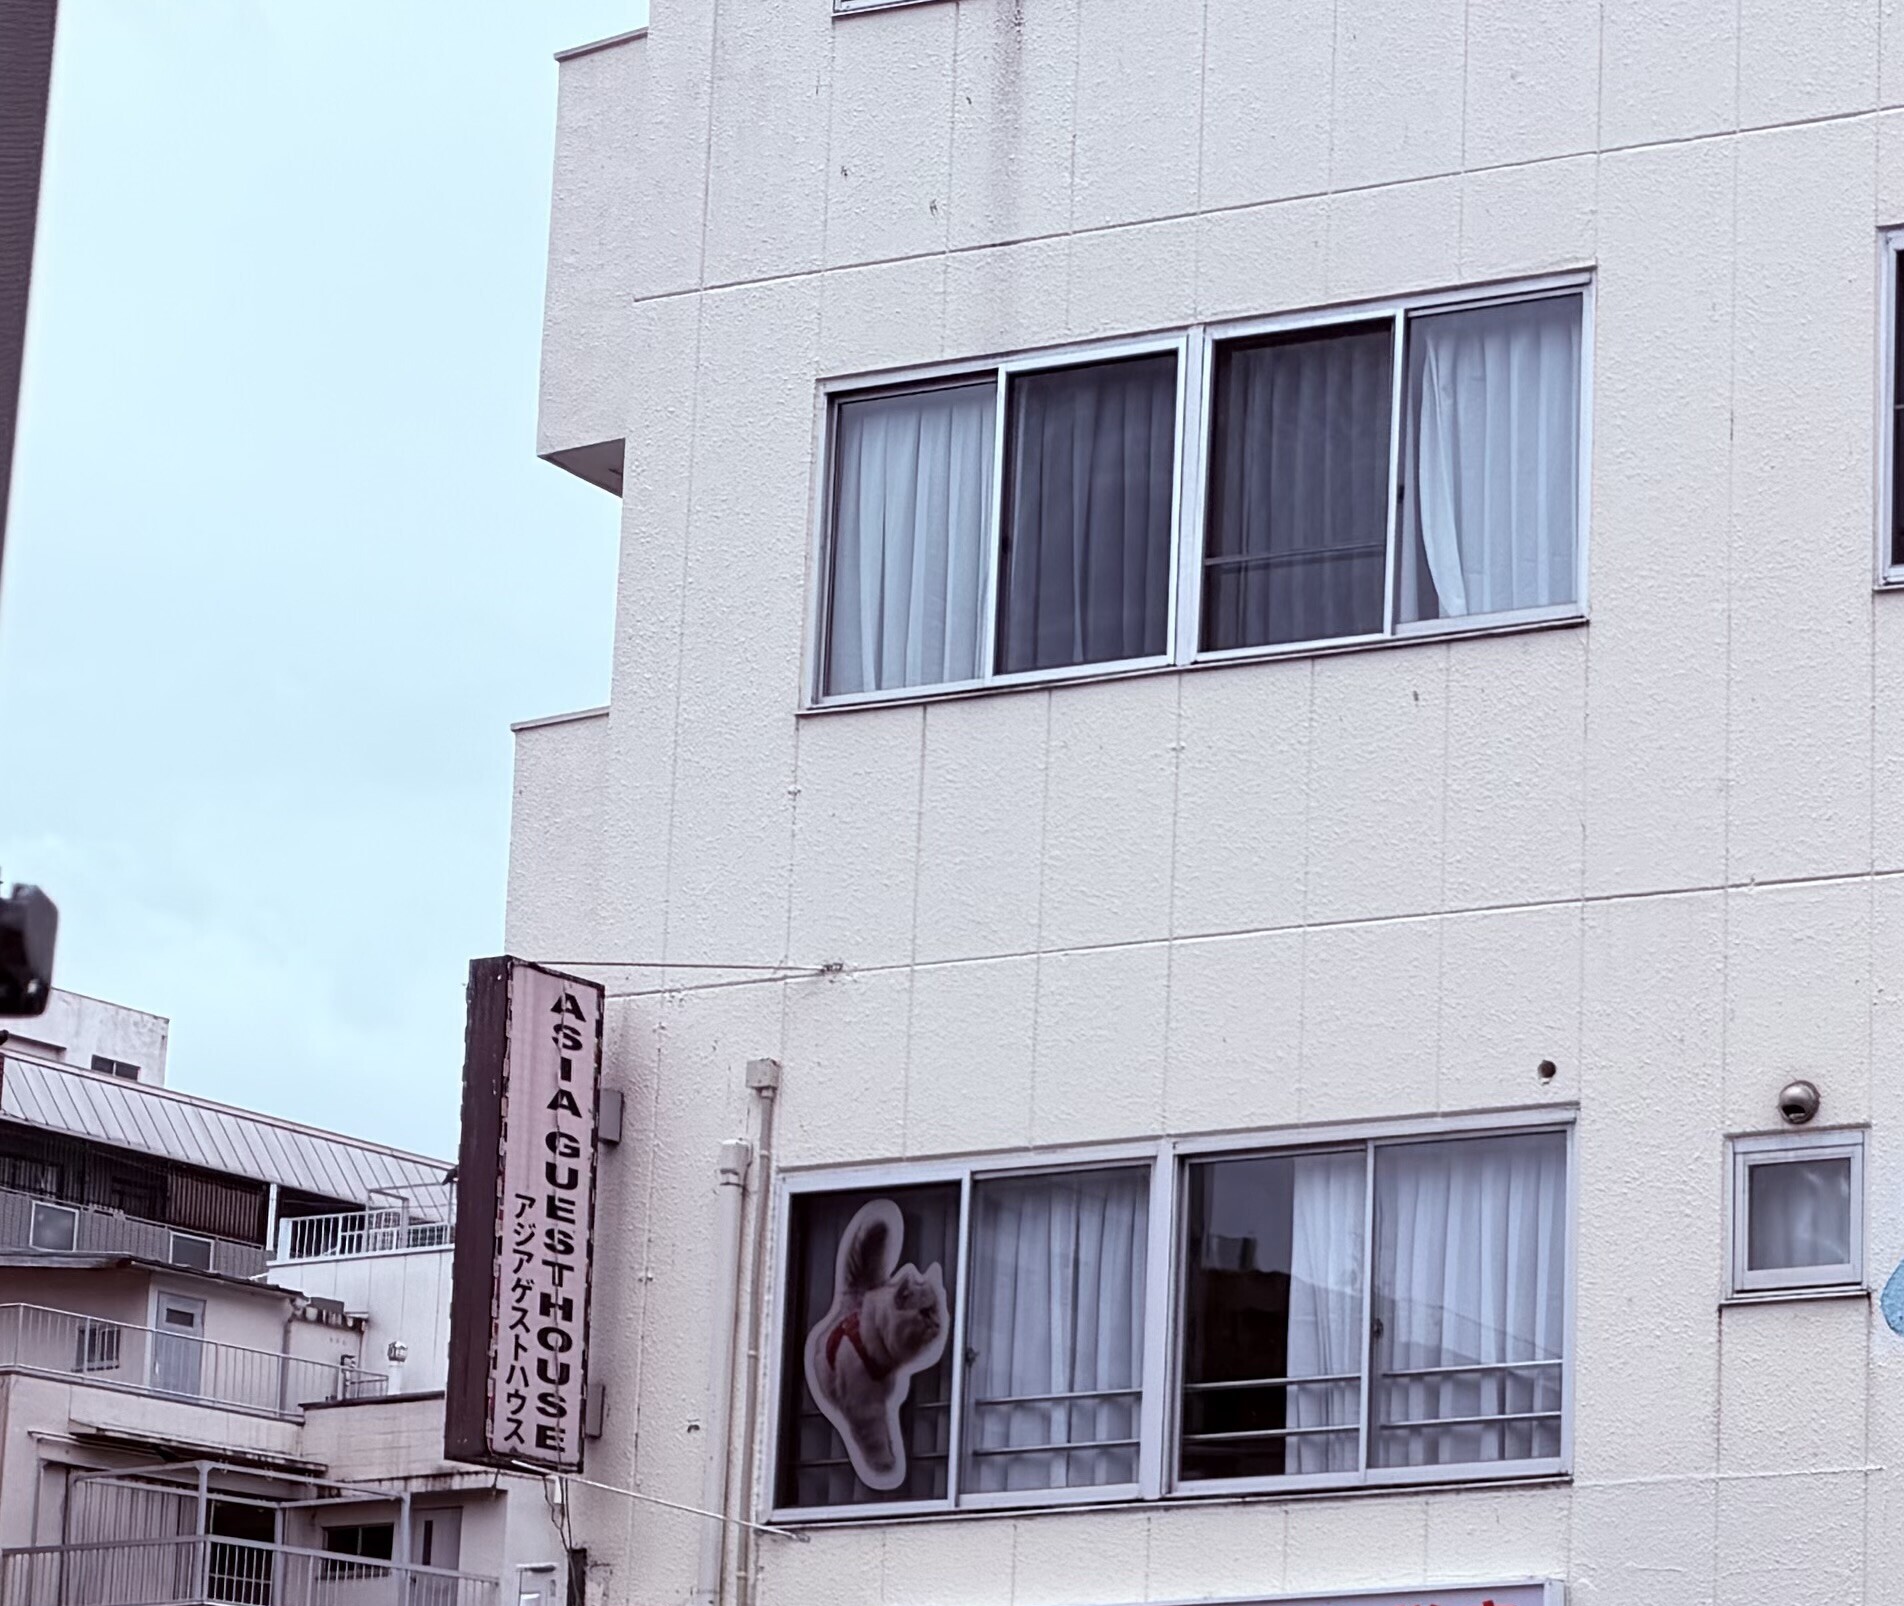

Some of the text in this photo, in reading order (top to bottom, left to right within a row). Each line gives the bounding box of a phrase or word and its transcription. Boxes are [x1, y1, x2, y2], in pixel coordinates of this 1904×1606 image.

[504, 1193, 536, 1444] アジアゲストハウス
[535, 992, 587, 1453] ASIA GUESTHOUSE
